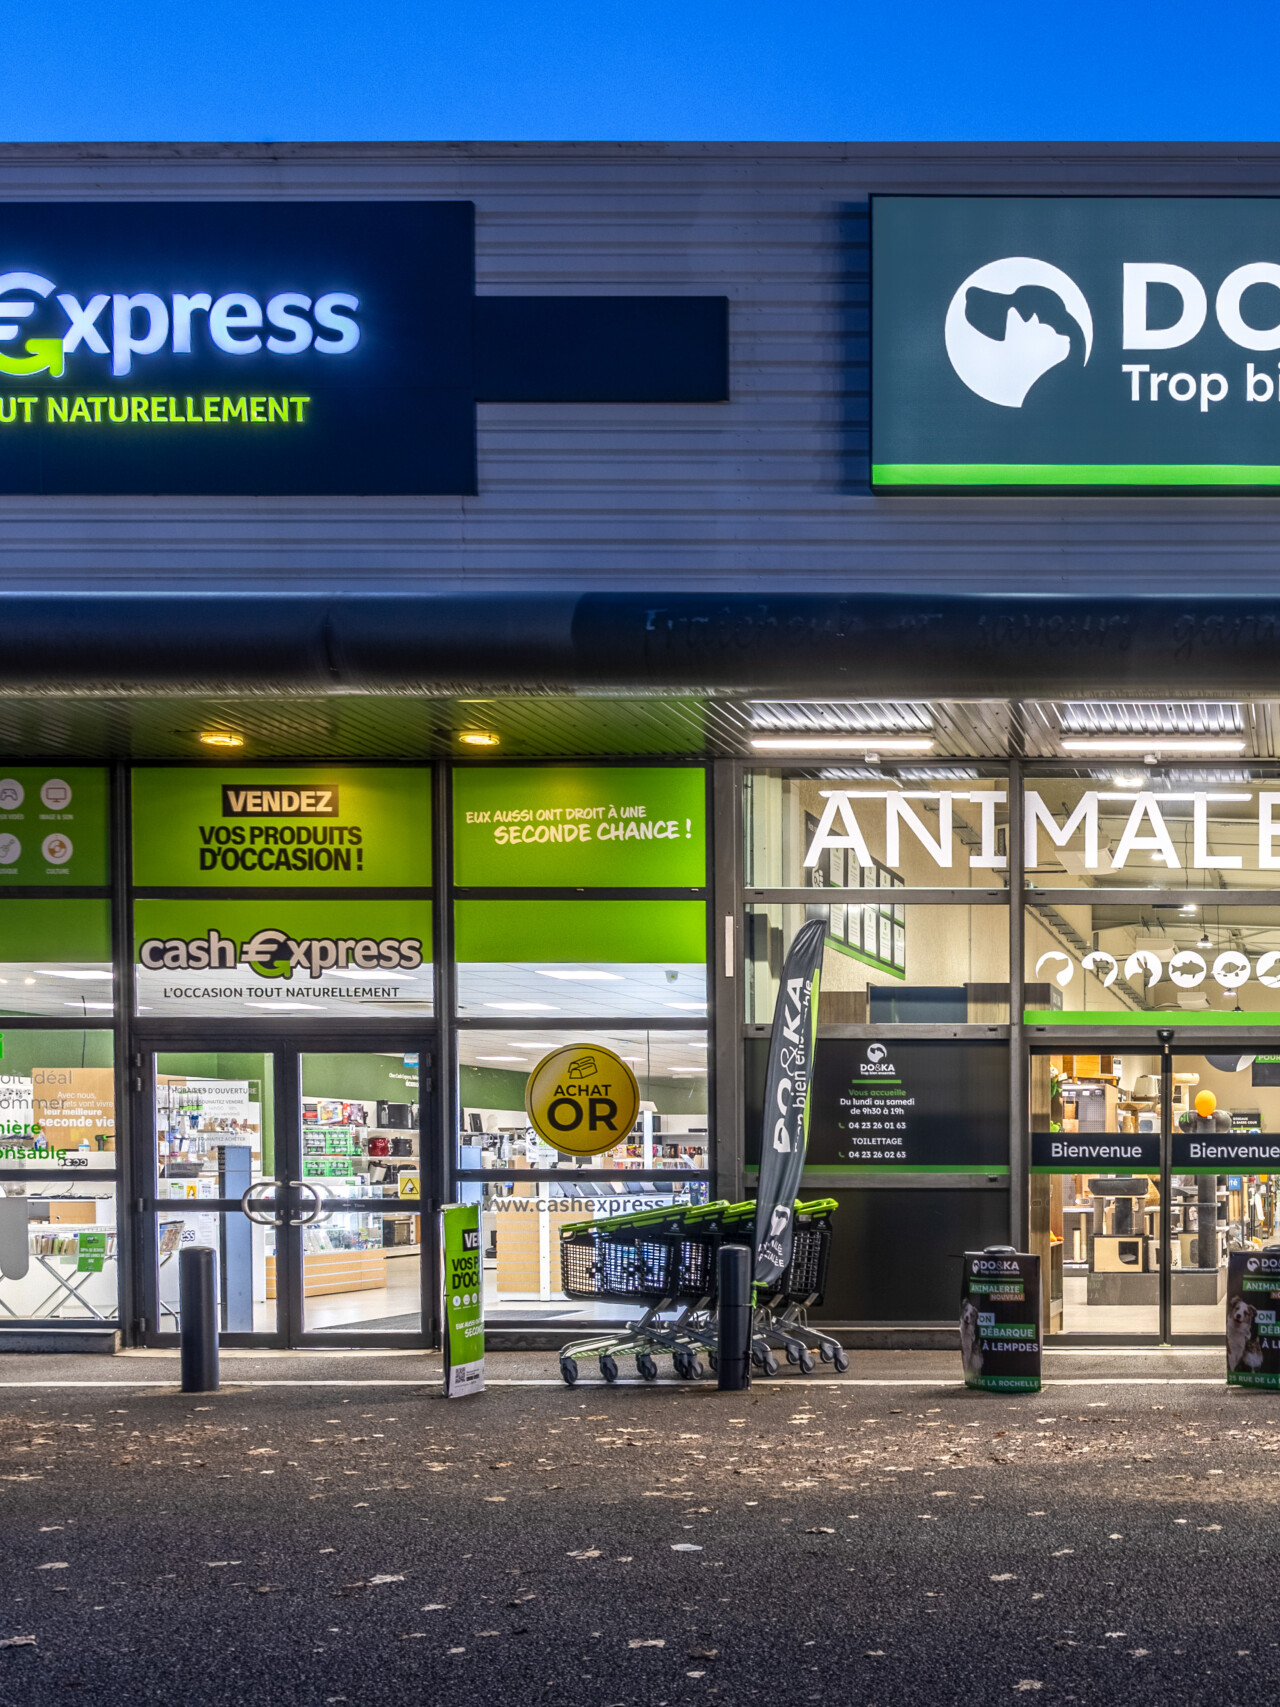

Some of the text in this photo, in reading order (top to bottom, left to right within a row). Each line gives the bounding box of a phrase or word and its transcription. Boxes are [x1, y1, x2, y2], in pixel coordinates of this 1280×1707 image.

[1122, 363, 1230, 412] Trop
[47, 396, 311, 424] NATURELLEMENT
[226, 790, 333, 813] VENDEZ
[466, 804, 647, 823] EUX AUSSI ONT DROIT À UNE
[199, 825, 363, 845] VOS PRODUITS
[493, 818, 692, 845] SECONDE CHANCE !
[164, 987, 400, 998] L'OCCASION TOUT NATURELLEMENT
[860, 1063, 896, 1072] DO&KA
[30, 1070, 72, 1085] idéal
[208, 1087, 257, 1095] D'OUVERTURE
[553, 1084, 612, 1097] ACHAT
[870, 1088, 906, 1096] accueille
[840, 1098, 851, 1106] Du
[853, 1098, 873, 1106] lundi
[886, 1098, 915, 1106] samedi
[546, 1097, 618, 1132] OR
[850, 1107, 905, 1115] de 9h30 à 19h
[39, 1116, 114, 1128] seconde vie
[852, 1137, 903, 1145] TOILETTAGE
[848, 1151, 906, 1159] 04 23 26 02 63
[1050, 1142, 1142, 1158] Bienvenue
[1189, 1143, 1280, 1158] Bienvenue
[452, 1257, 472, 1272] VOS
[980, 1261, 1019, 1270] DO&KA
[971, 1284, 1020, 1293] ANIMALERIE
[980, 1314, 992, 1323] ON
[1258, 1313, 1272, 1321] ON
[980, 1325, 1034, 1338] DÉBARQUE
[982, 1340, 1039, 1352] À LEMPDES
[1262, 1338, 1269, 1348] À
[1000, 1380, 1039, 1388] ROCHELLE
